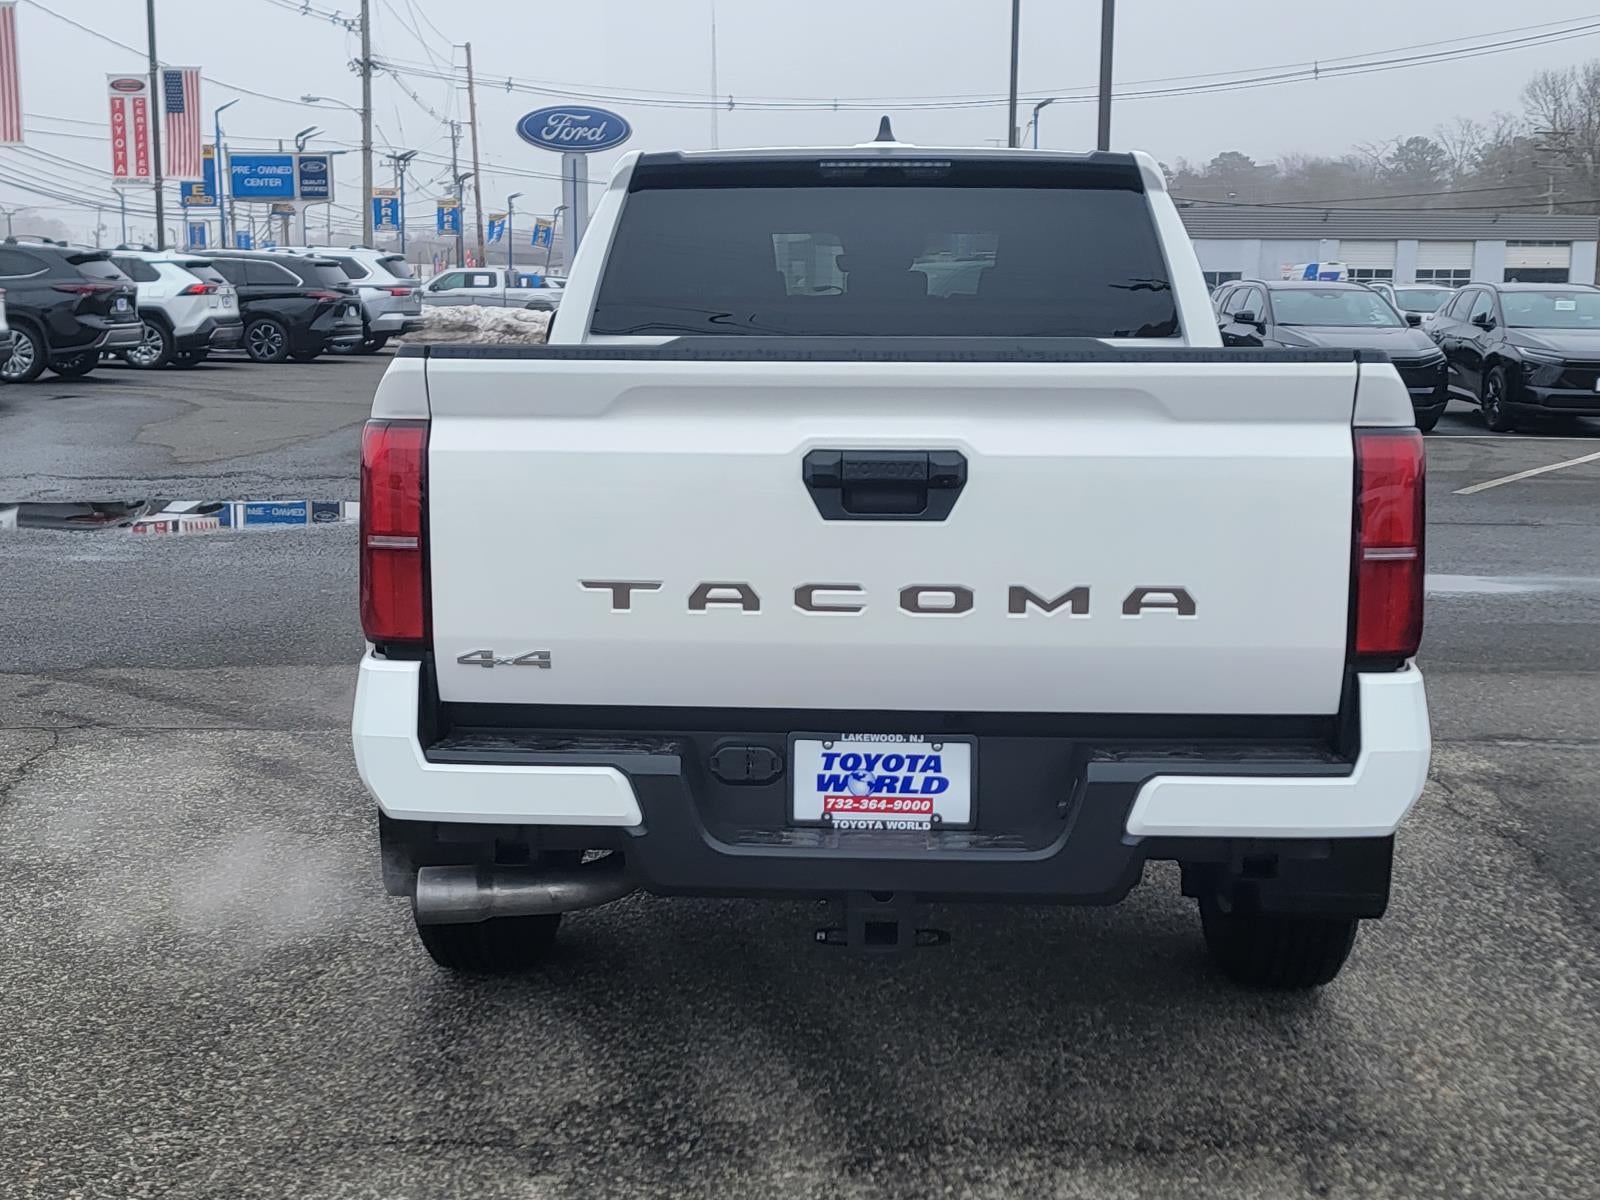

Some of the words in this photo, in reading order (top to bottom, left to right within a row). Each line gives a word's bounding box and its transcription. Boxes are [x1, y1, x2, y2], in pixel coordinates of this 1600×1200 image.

[113, 99, 126, 174] TOYOTA
[135, 100, 148, 175] CERTIFIED
[541, 113, 607, 141] Ford
[244, 177, 282, 187] CENTER
[381, 198, 392, 224] PRE
[846, 462, 924, 478] TOYOTA
[579, 580, 1198, 617] TACOMA
[909, 734, 925, 743] NJ
[821, 752, 942, 773] TOYOTA
[826, 798, 931, 811] 732-364-9000
[832, 820, 883, 829] TOYOTA
[886, 821, 931, 830] WORLD
